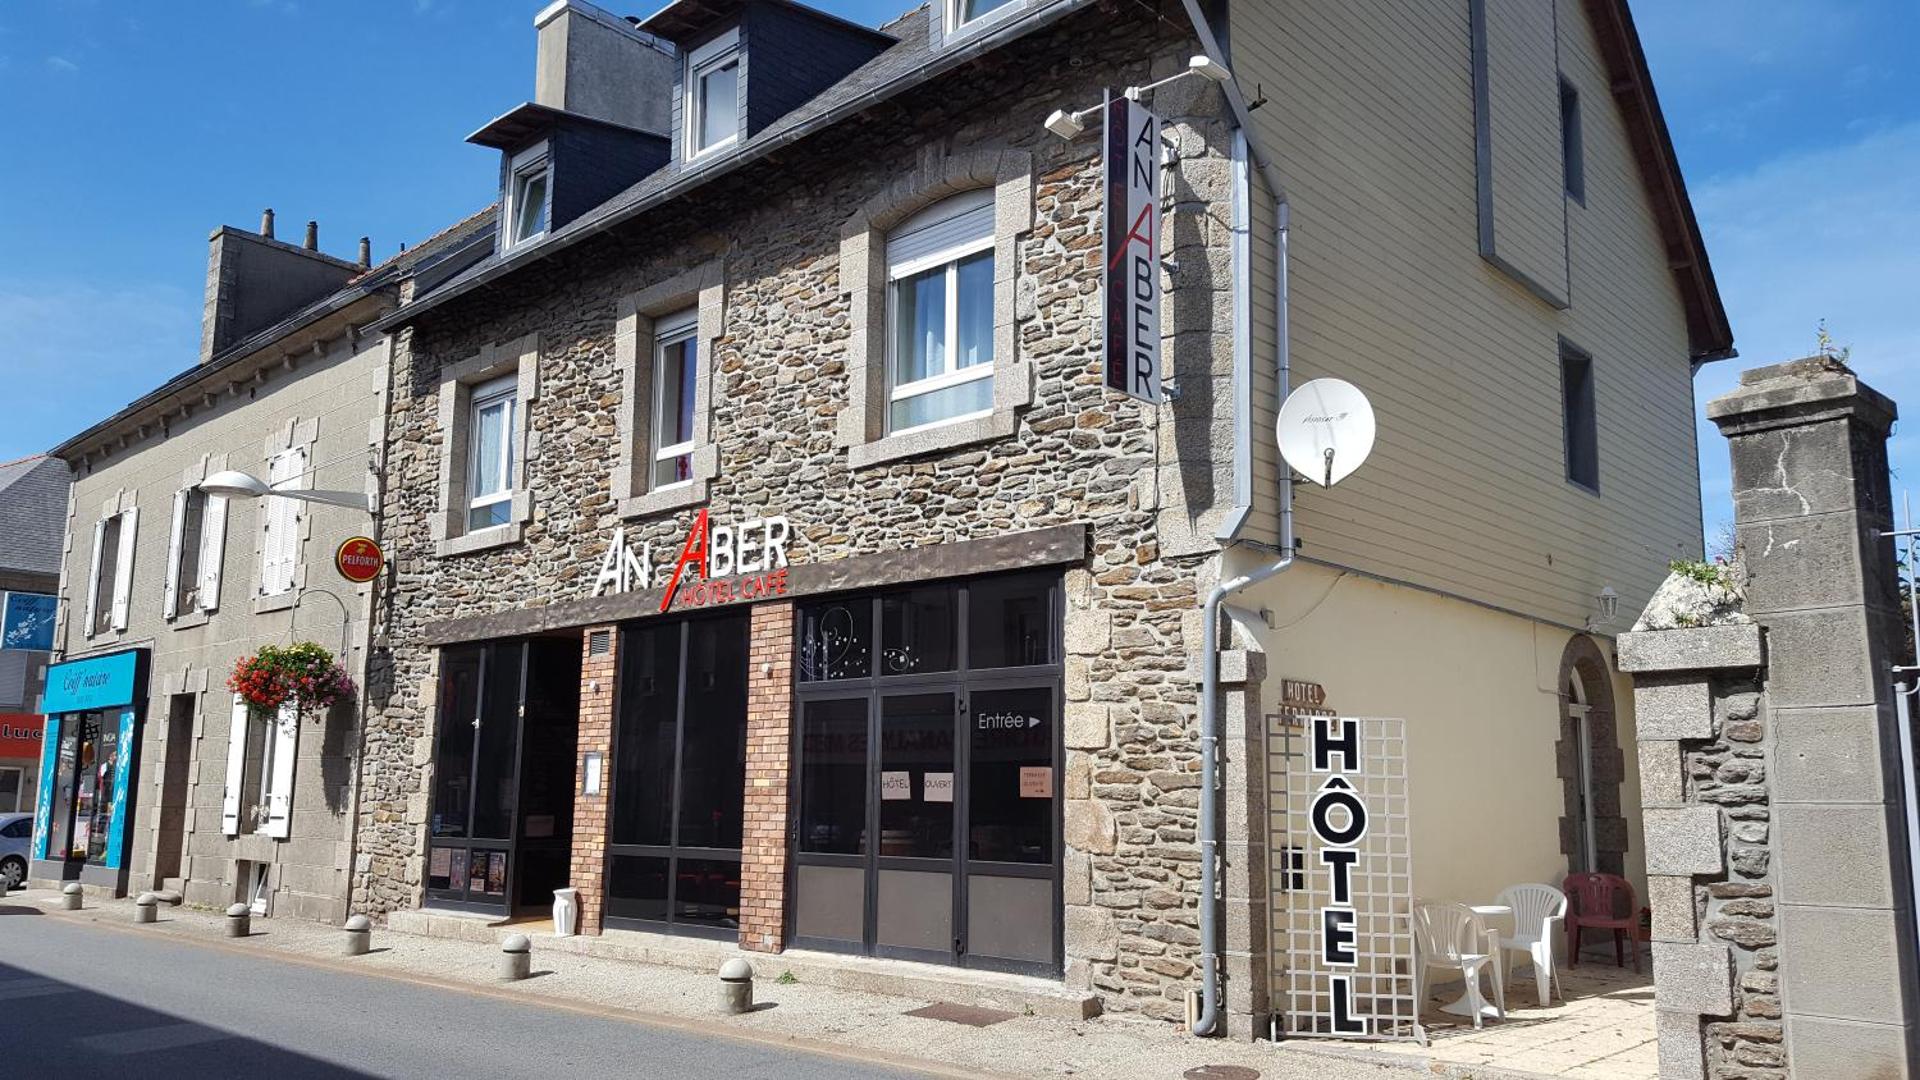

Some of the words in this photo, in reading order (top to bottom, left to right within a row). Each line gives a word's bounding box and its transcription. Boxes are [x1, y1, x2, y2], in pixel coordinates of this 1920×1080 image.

[1133, 116, 1153, 197] AN
[1109, 202, 1154, 399] ABER
[342, 554, 379, 567] PELFORTH
[591, 526, 651, 598] AN
[659, 508, 789, 612] ABER
[978, 712, 1024, 730] Entrée
[1287, 681, 1321, 704] HOTEL
[1309, 716, 1368, 1037] HÔTEL
